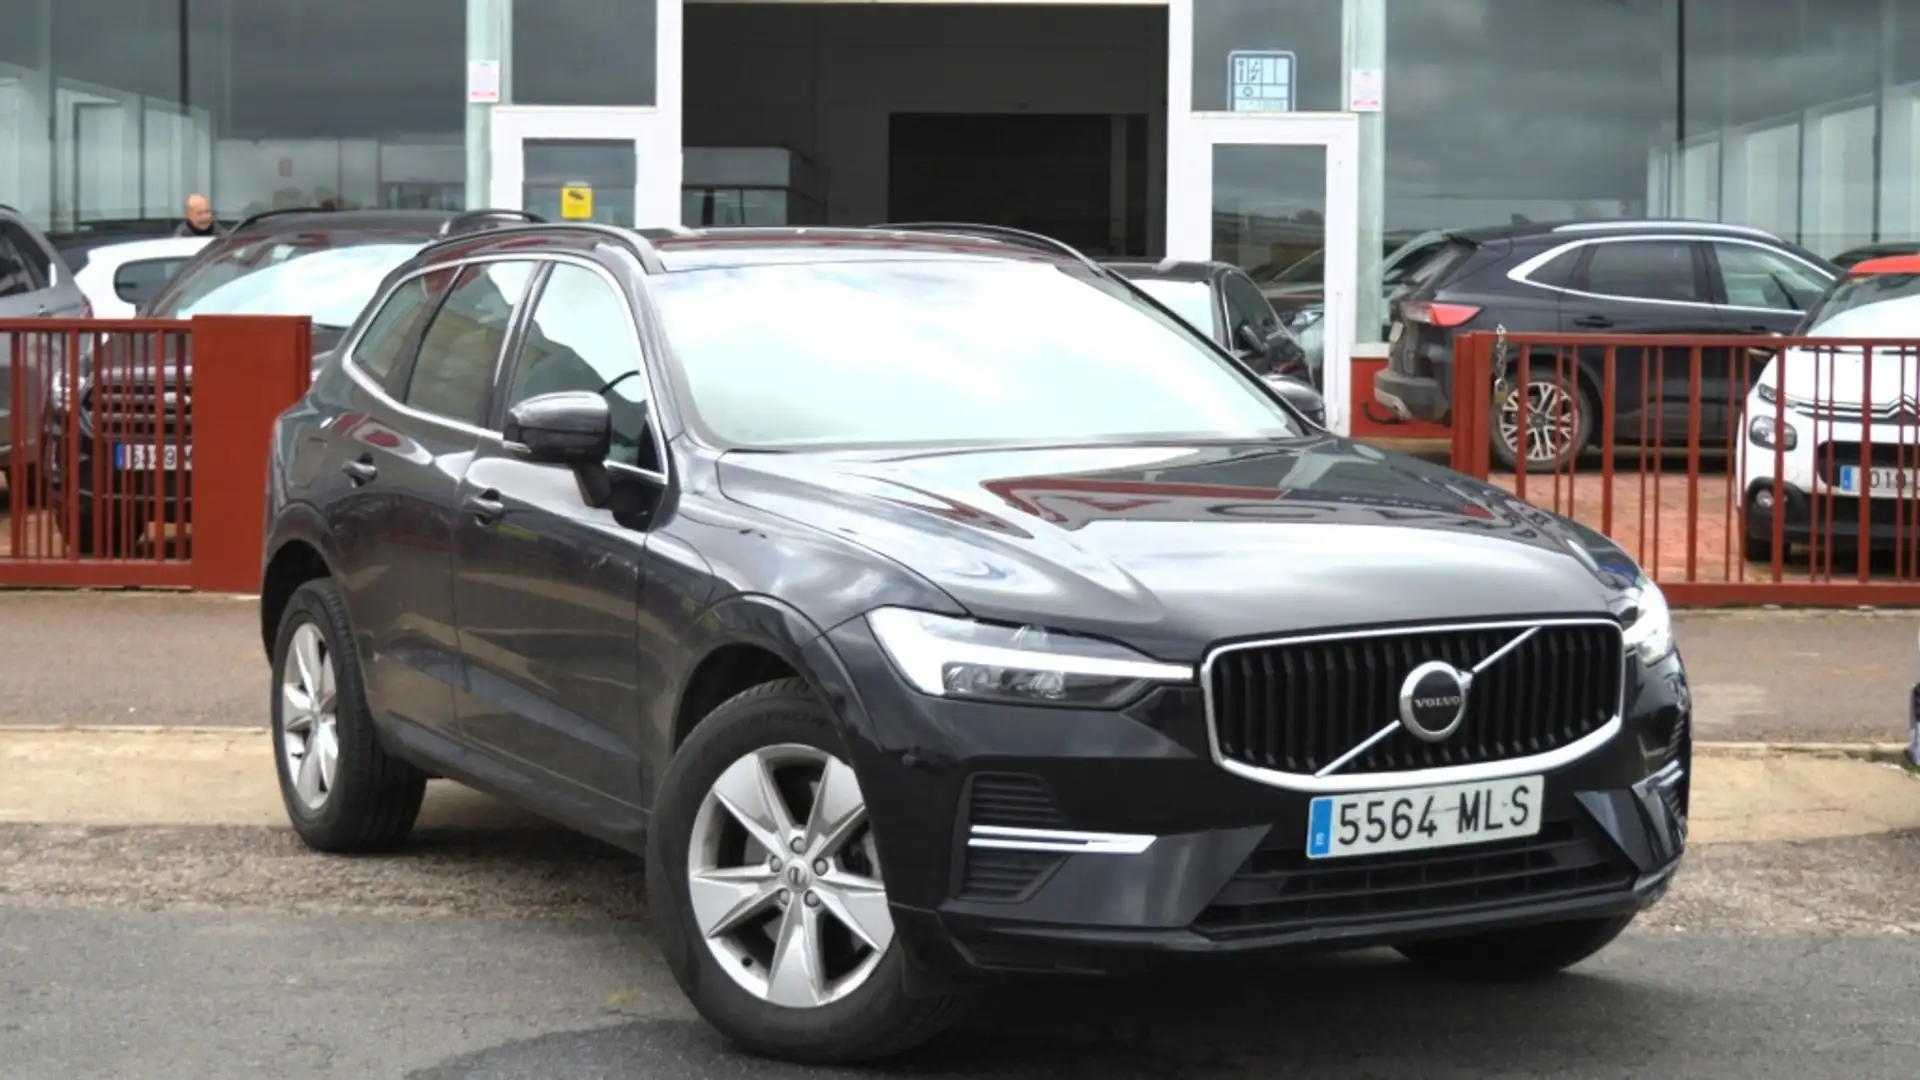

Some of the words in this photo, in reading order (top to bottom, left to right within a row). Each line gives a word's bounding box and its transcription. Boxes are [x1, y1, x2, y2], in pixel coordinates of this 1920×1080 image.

[1414, 695, 1460, 708] VOLVO
[1338, 795, 1438, 846] 5564
[1457, 784, 1530, 834] MLS
